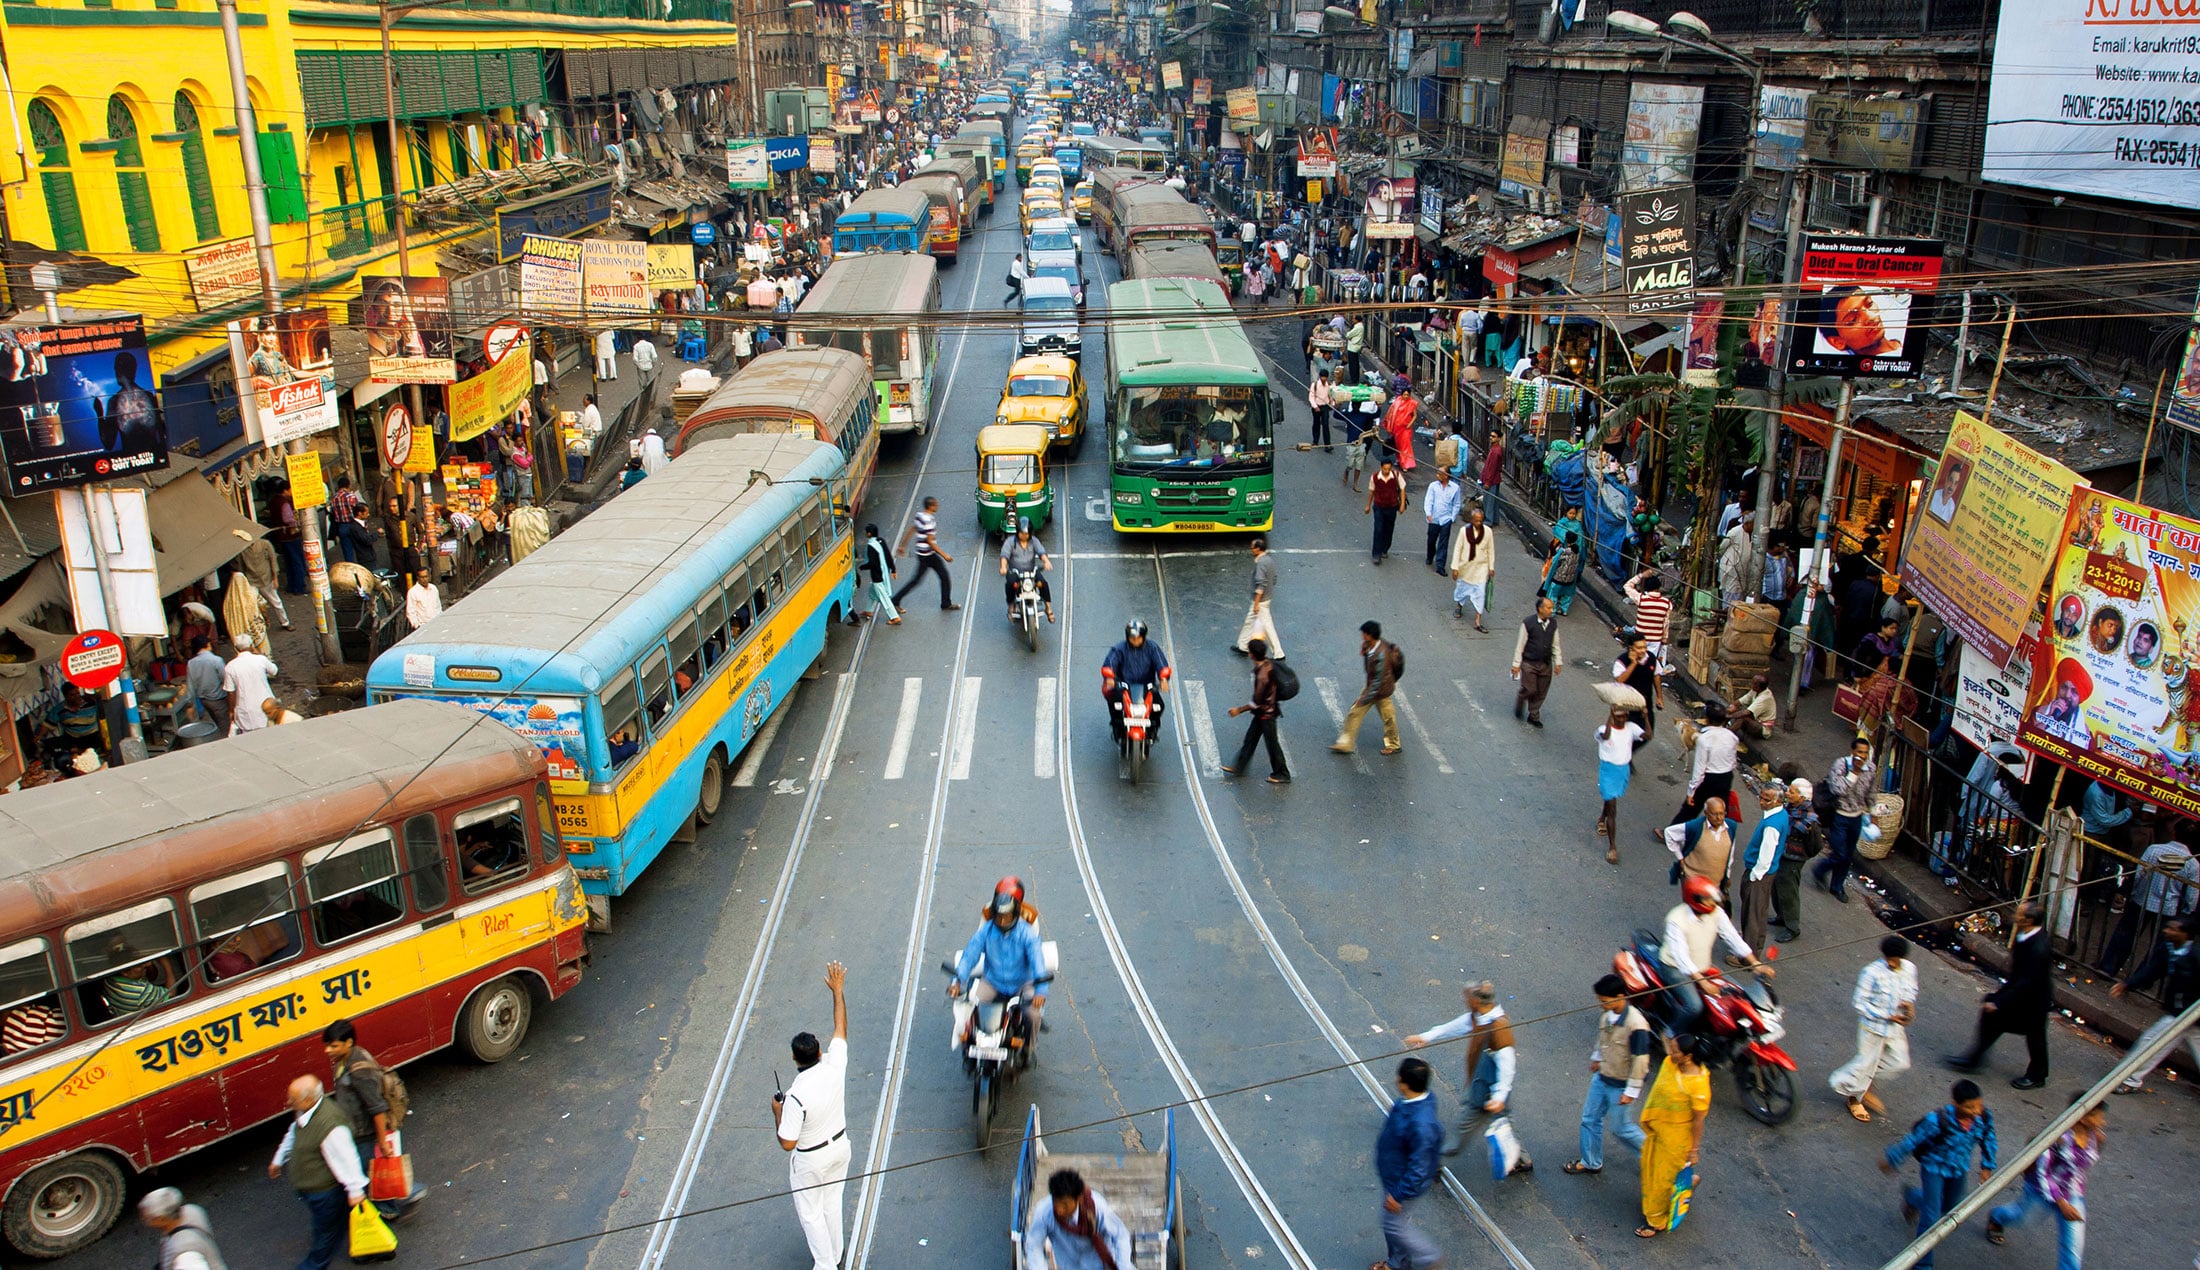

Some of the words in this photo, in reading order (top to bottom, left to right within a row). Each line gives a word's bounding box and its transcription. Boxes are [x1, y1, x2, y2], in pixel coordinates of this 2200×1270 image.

[2096, 64, 2141, 81] Website
[766, 148, 801, 160] OKIA
[524, 237, 583, 262] ABHISHEK
[586, 242, 616, 255] ROYAL
[620, 243, 645, 256] TOUCH
[1811, 242, 1838, 251] Mukesh
[1840, 244, 1865, 252] Harane
[1866, 245, 1893, 254] 24-year
[1894, 246, 1905, 254] old
[586, 257, 621, 266] CREATIONS
[1809, 255, 1835, 269] Died
[1856, 258, 1880, 270] Oral
[1882, 258, 1925, 272] Cancer
[229, 268, 260, 285] TRADERS
[525, 274, 556, 283] EXCLUSIVE
[539, 269, 557, 277] HOUSE
[1632, 262, 1691, 294] Mala
[590, 283, 644, 301] Raymond
[59, 327, 84, 341] lungs
[85, 326, 99, 335] are
[115, 323, 124, 333] of
[42, 344, 62, 357] that
[62, 343, 93, 355] causes
[93, 338, 123, 351] cancer
[371, 359, 400, 369] Madanji
[440, 360, 452, 369] Co.
[273, 380, 319, 411] Ashok
[2003, 438, 2013, 450] श्री
[111, 461, 130, 471] QUIT
[132, 457, 155, 468] TODAY
[2112, 507, 2166, 543] माता
[2169, 525, 2200, 554] का
[2147, 549, 2183, 573] स्थान-
[2086, 563, 2141, 593] 23-1-2013
[2105, 583, 2111, 591] 4
[79, 652, 97, 661] ENTRY
[97, 647, 118, 658] EXCEPT
[2022, 724, 2073, 762] आयोजक-
[2076, 752, 2112, 783] हावड़ा
[2115, 764, 2146, 794] जिला
[2102, 740, 2140, 765] 25-1-2013
[561, 817, 588, 827] 0565
[136, 1011, 242, 1072] হাওড়া
[249, 992, 308, 1030] ফাঃ
[321, 967, 373, 1006] সাঃ
